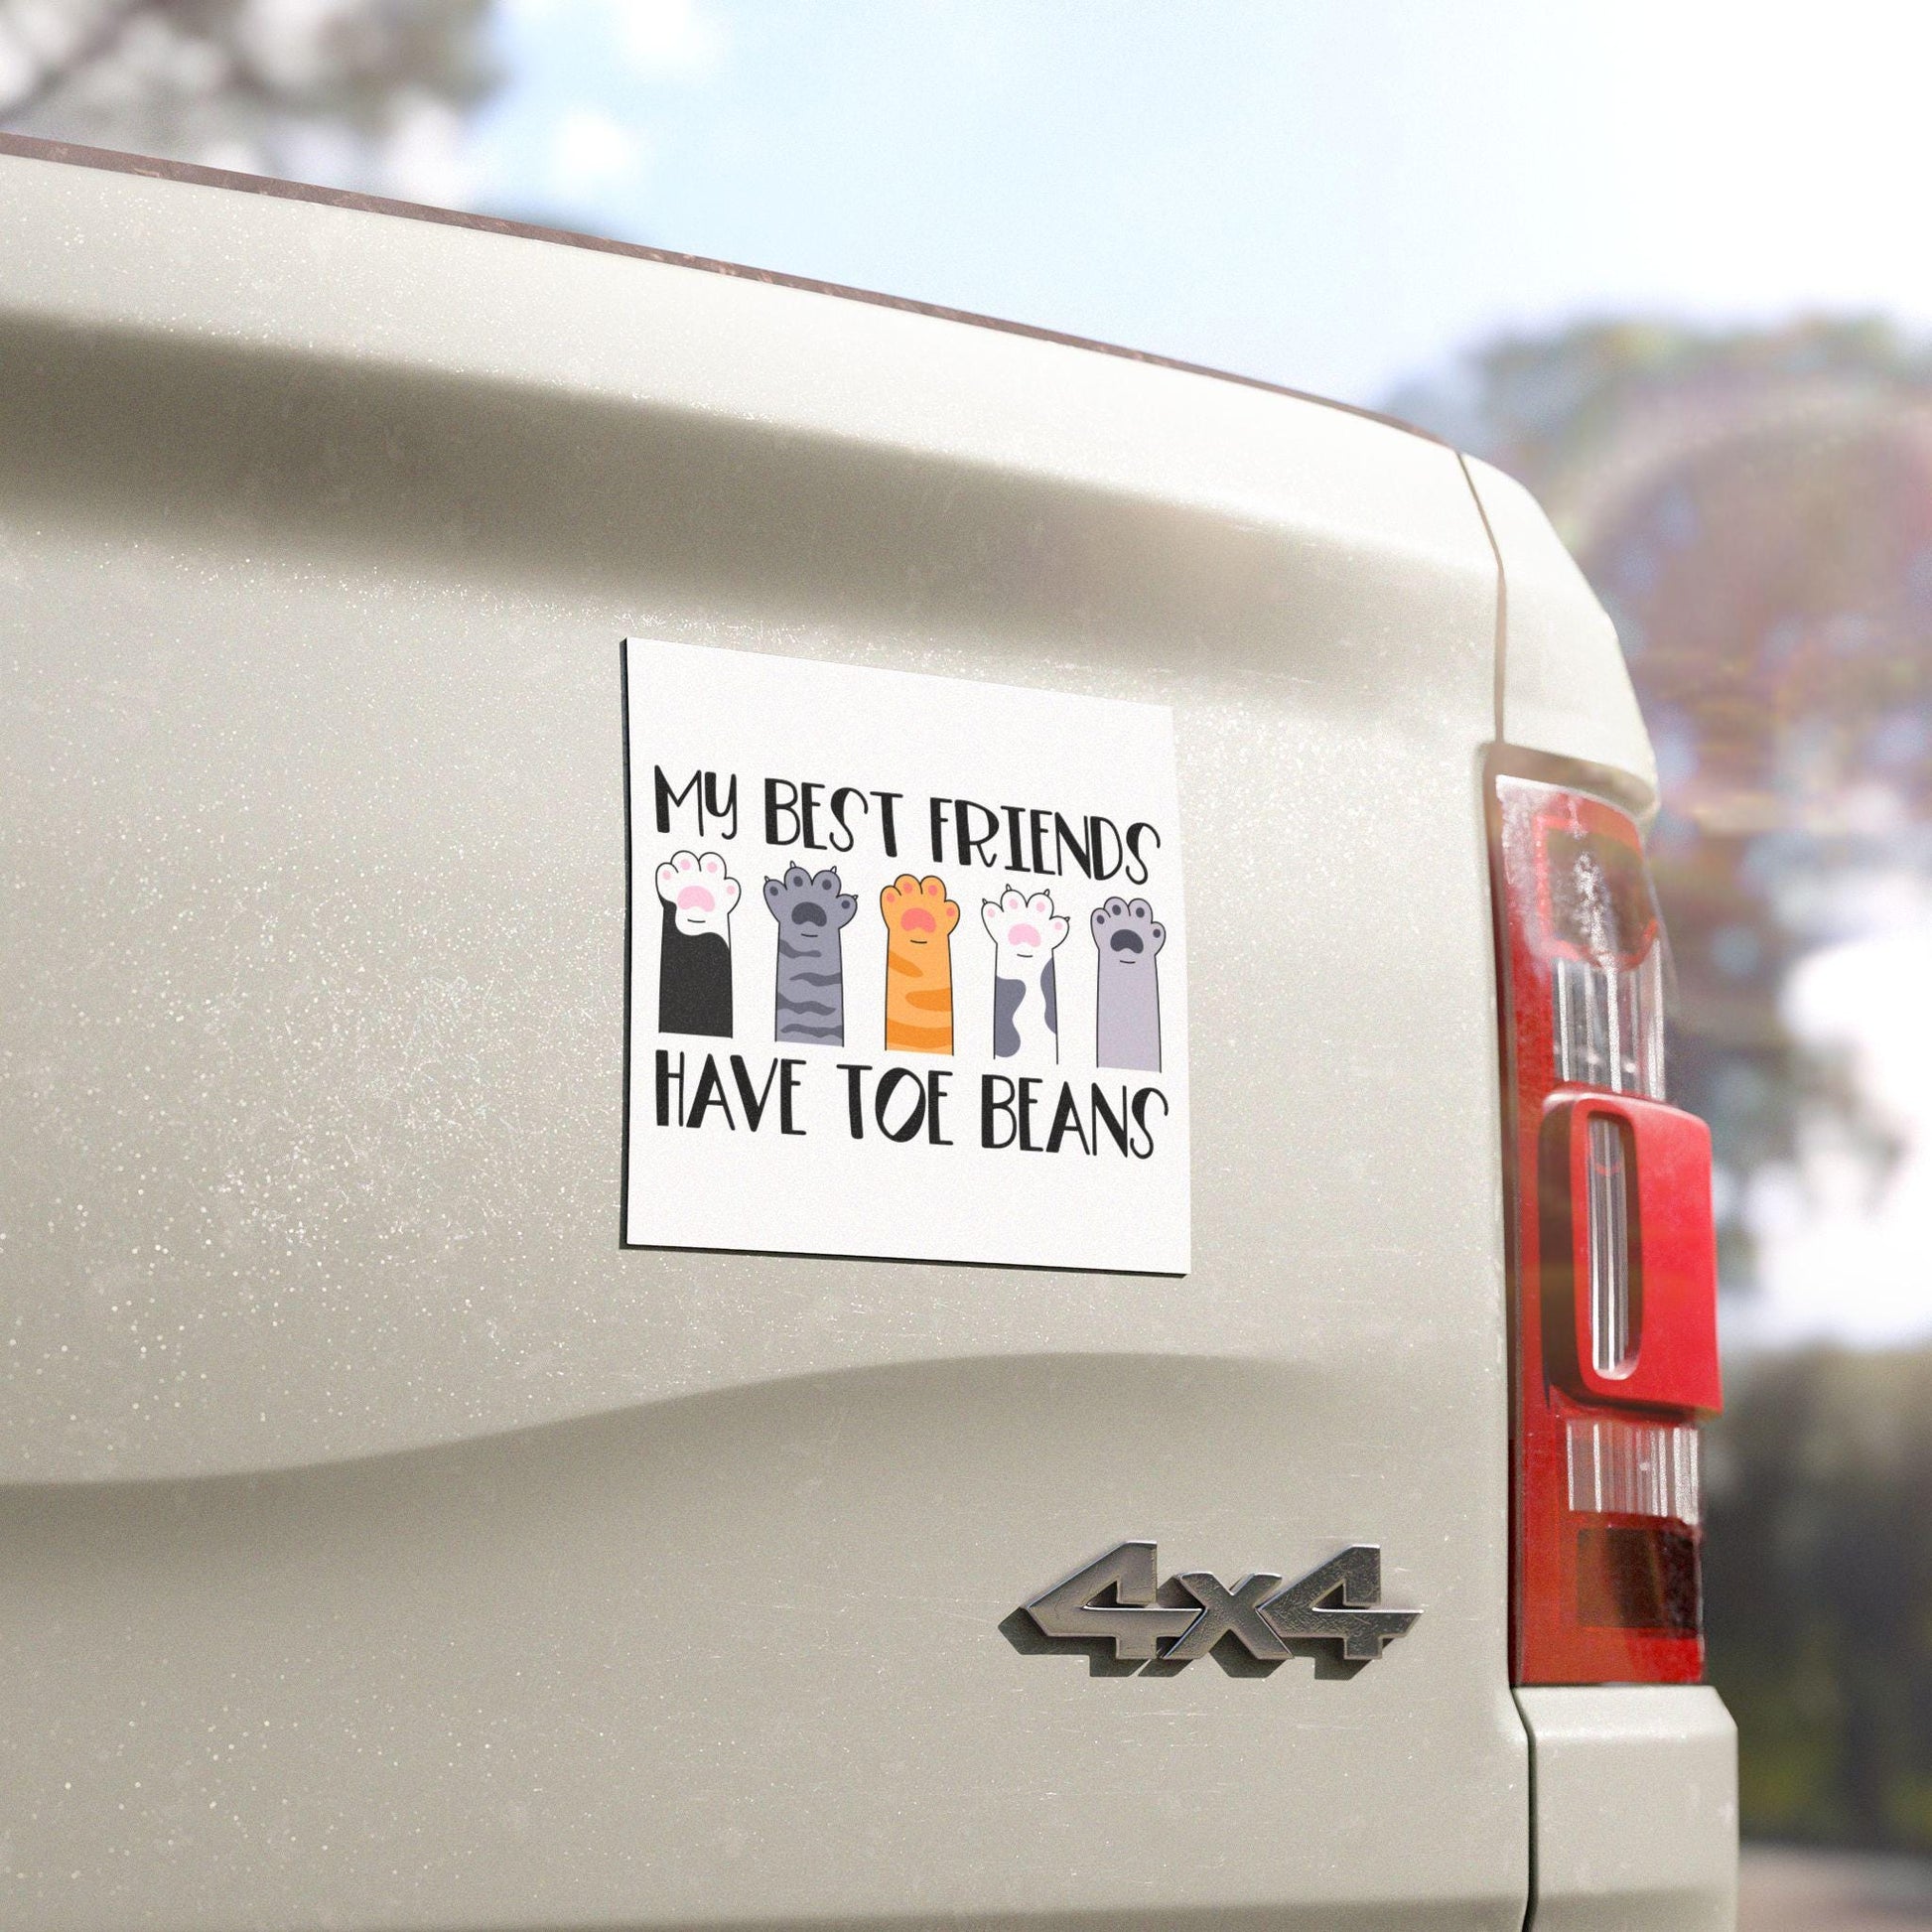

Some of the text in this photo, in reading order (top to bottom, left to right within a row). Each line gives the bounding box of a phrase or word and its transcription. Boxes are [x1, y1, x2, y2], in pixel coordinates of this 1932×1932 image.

[764, 777, 903, 858] BEST
[929, 796, 1162, 886] FRIENDS
[654, 1049, 1170, 1160] HAVE TOE BEANS
